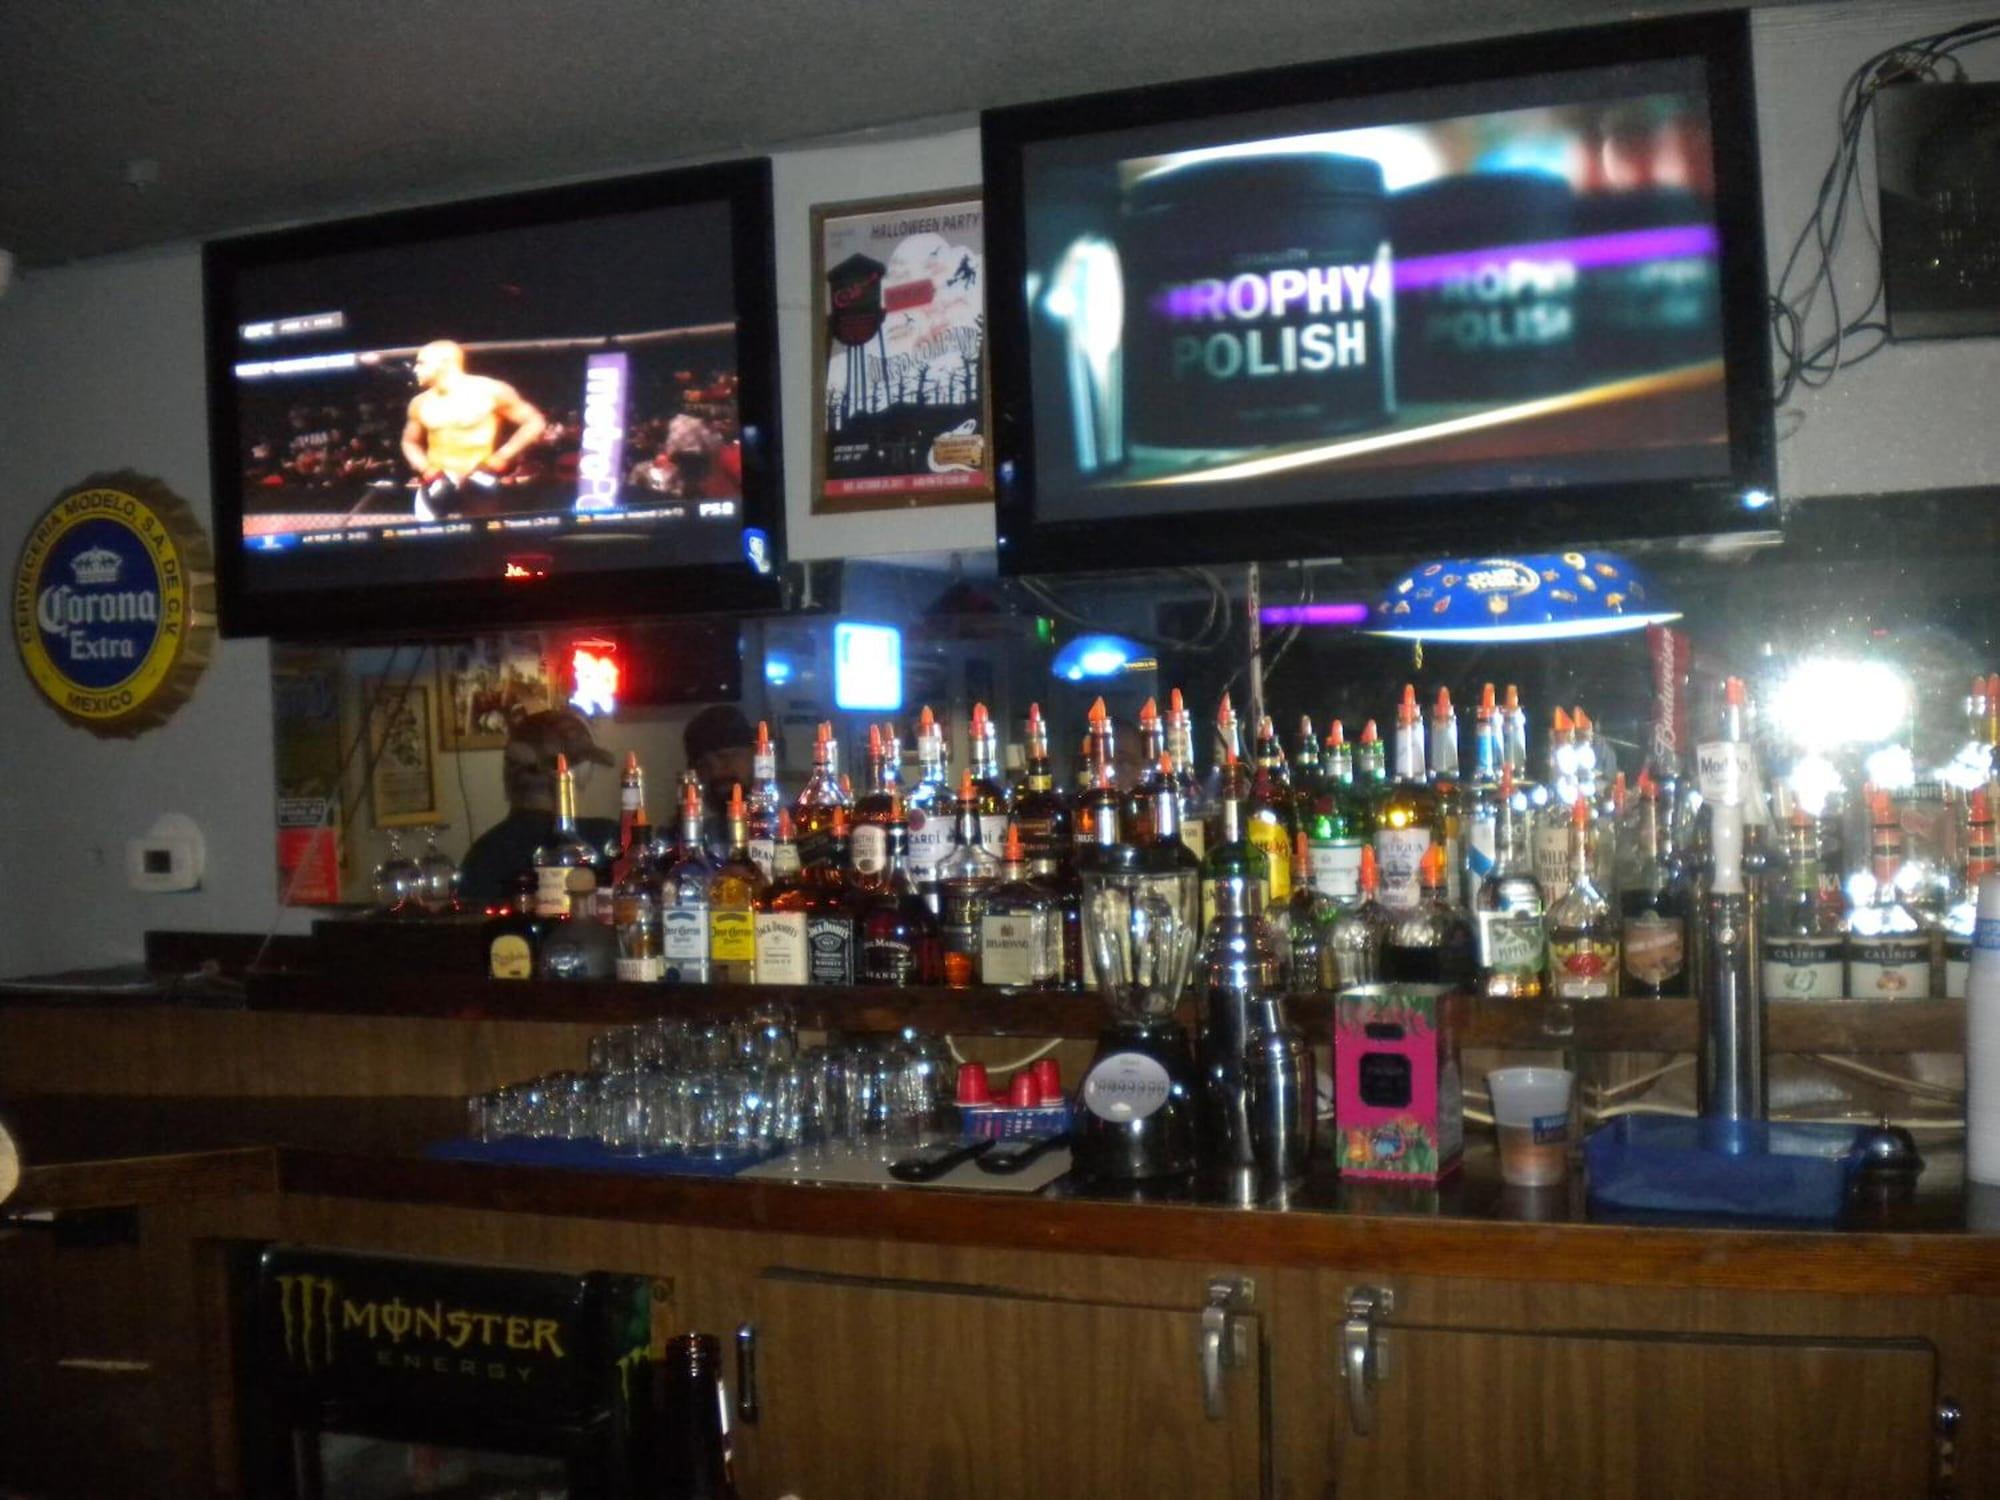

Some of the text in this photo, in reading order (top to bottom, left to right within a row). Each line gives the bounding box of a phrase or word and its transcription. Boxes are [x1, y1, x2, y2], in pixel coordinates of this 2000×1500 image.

[870, 216, 940, 239] HALLOWEEN
[1165, 265, 1372, 321] ROPHY
[1175, 320, 1368, 378] POLISH
[37, 584, 158, 637] Corona
[69, 630, 134, 660] Extra
[67, 690, 133, 713] MEXICO
[1652, 626, 1678, 760] Budweiser
[1701, 756, 1749, 774] Modlo
[341, 1296, 566, 1359] MONSTER
[376, 1350, 535, 1383] ENERGY
